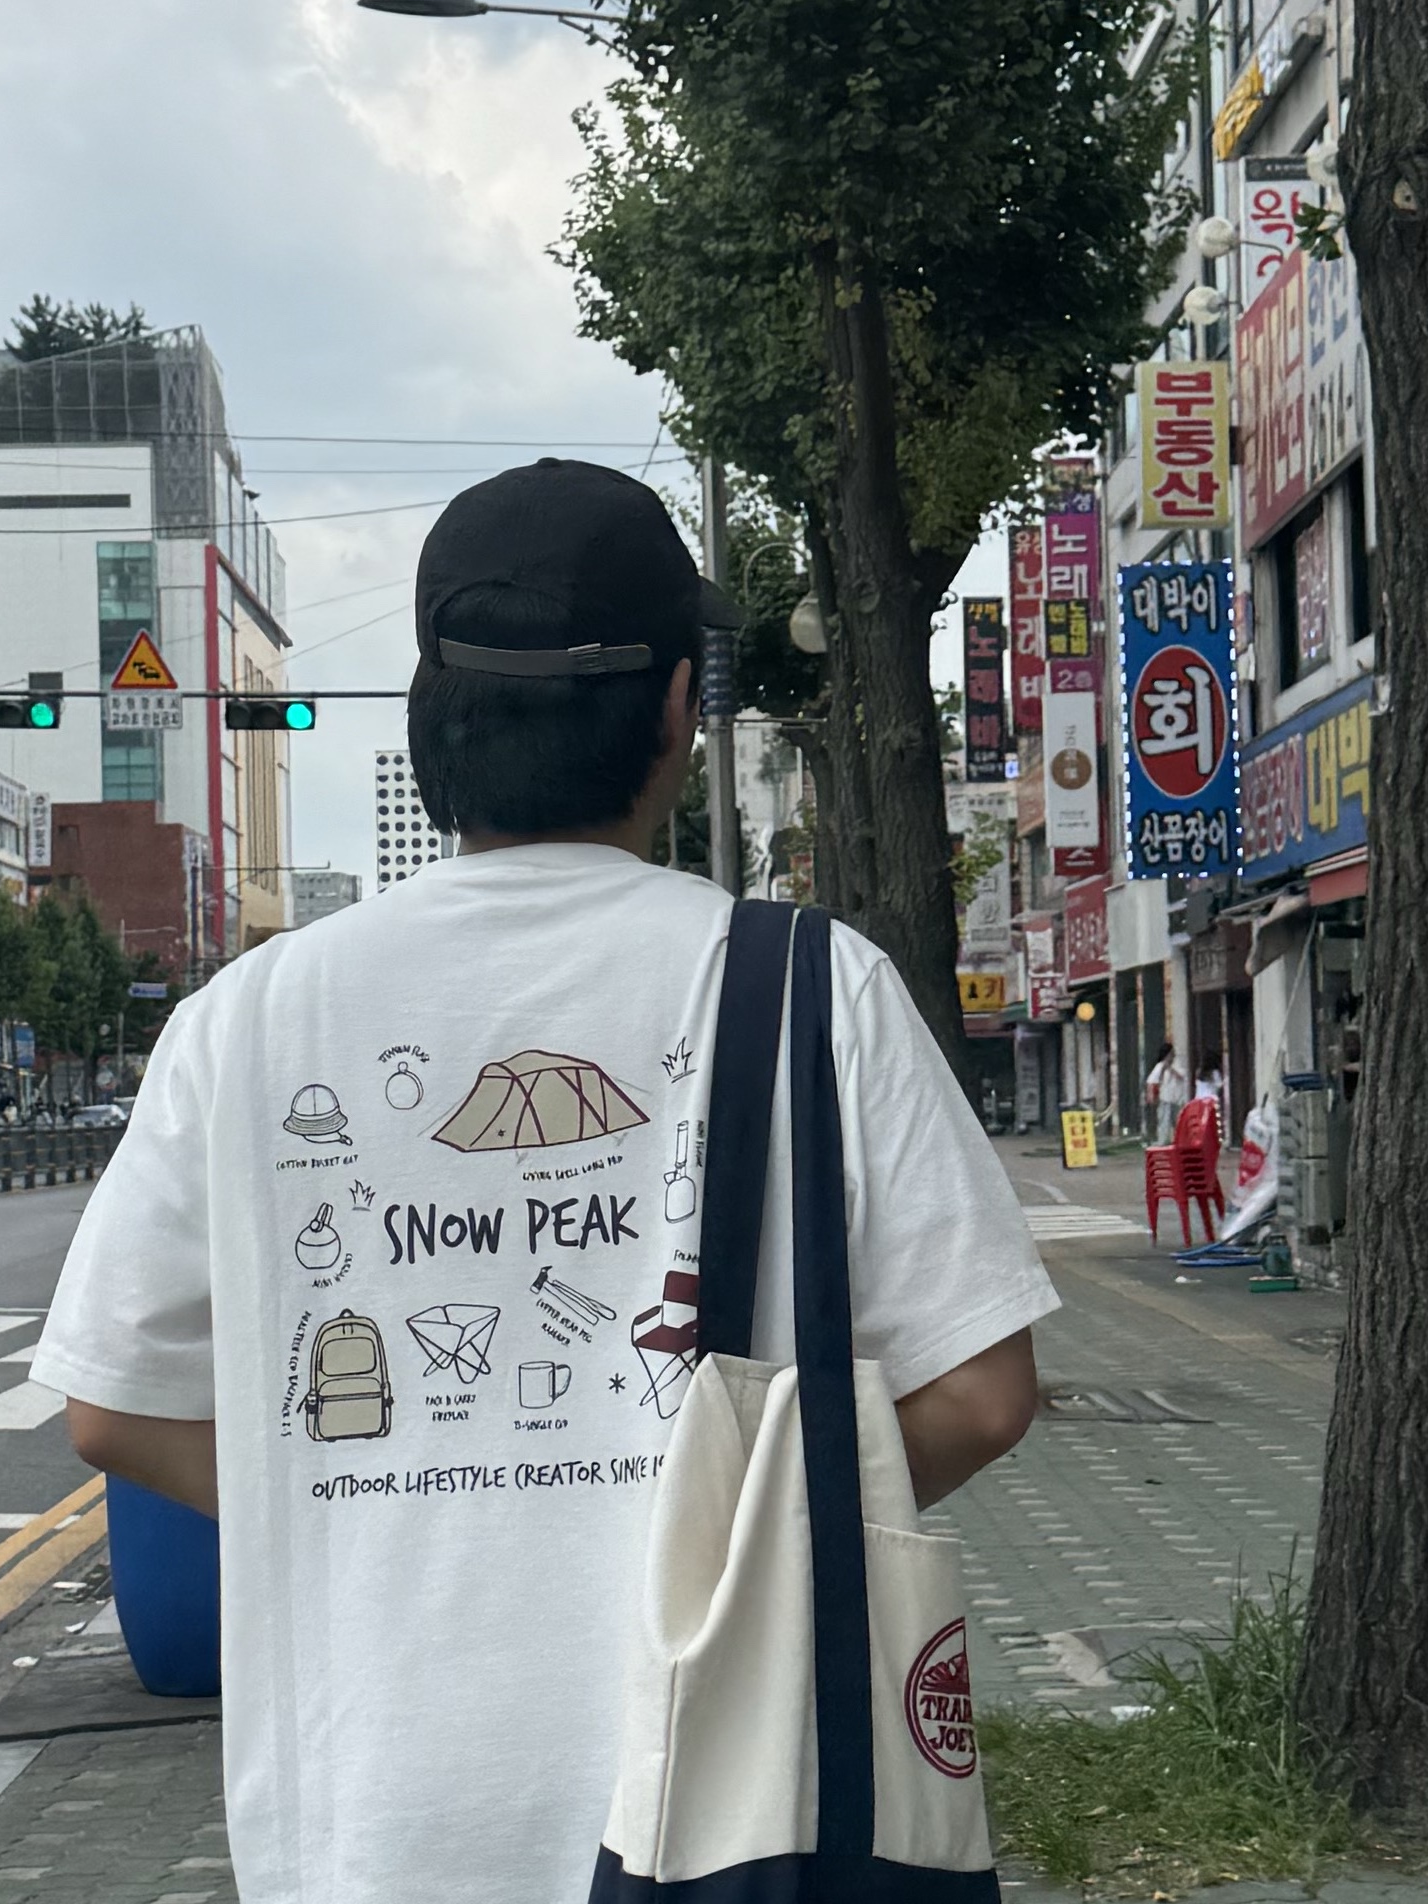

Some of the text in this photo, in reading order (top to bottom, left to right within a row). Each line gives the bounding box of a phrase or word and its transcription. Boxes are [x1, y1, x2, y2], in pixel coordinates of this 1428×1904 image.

[1153, 372, 1220, 517] 부동산
[1132, 574, 1217, 633] 대박이
[1139, 665, 1215, 774] 회
[383, 1194, 640, 1265] SNOW PEAK
[312, 1474, 400, 1501] OUTDOOR
[406, 1465, 507, 1497] LIFESTYLE
[514, 1460, 604, 1492] CREATOR
[609, 1456, 648, 1484] SINCE
